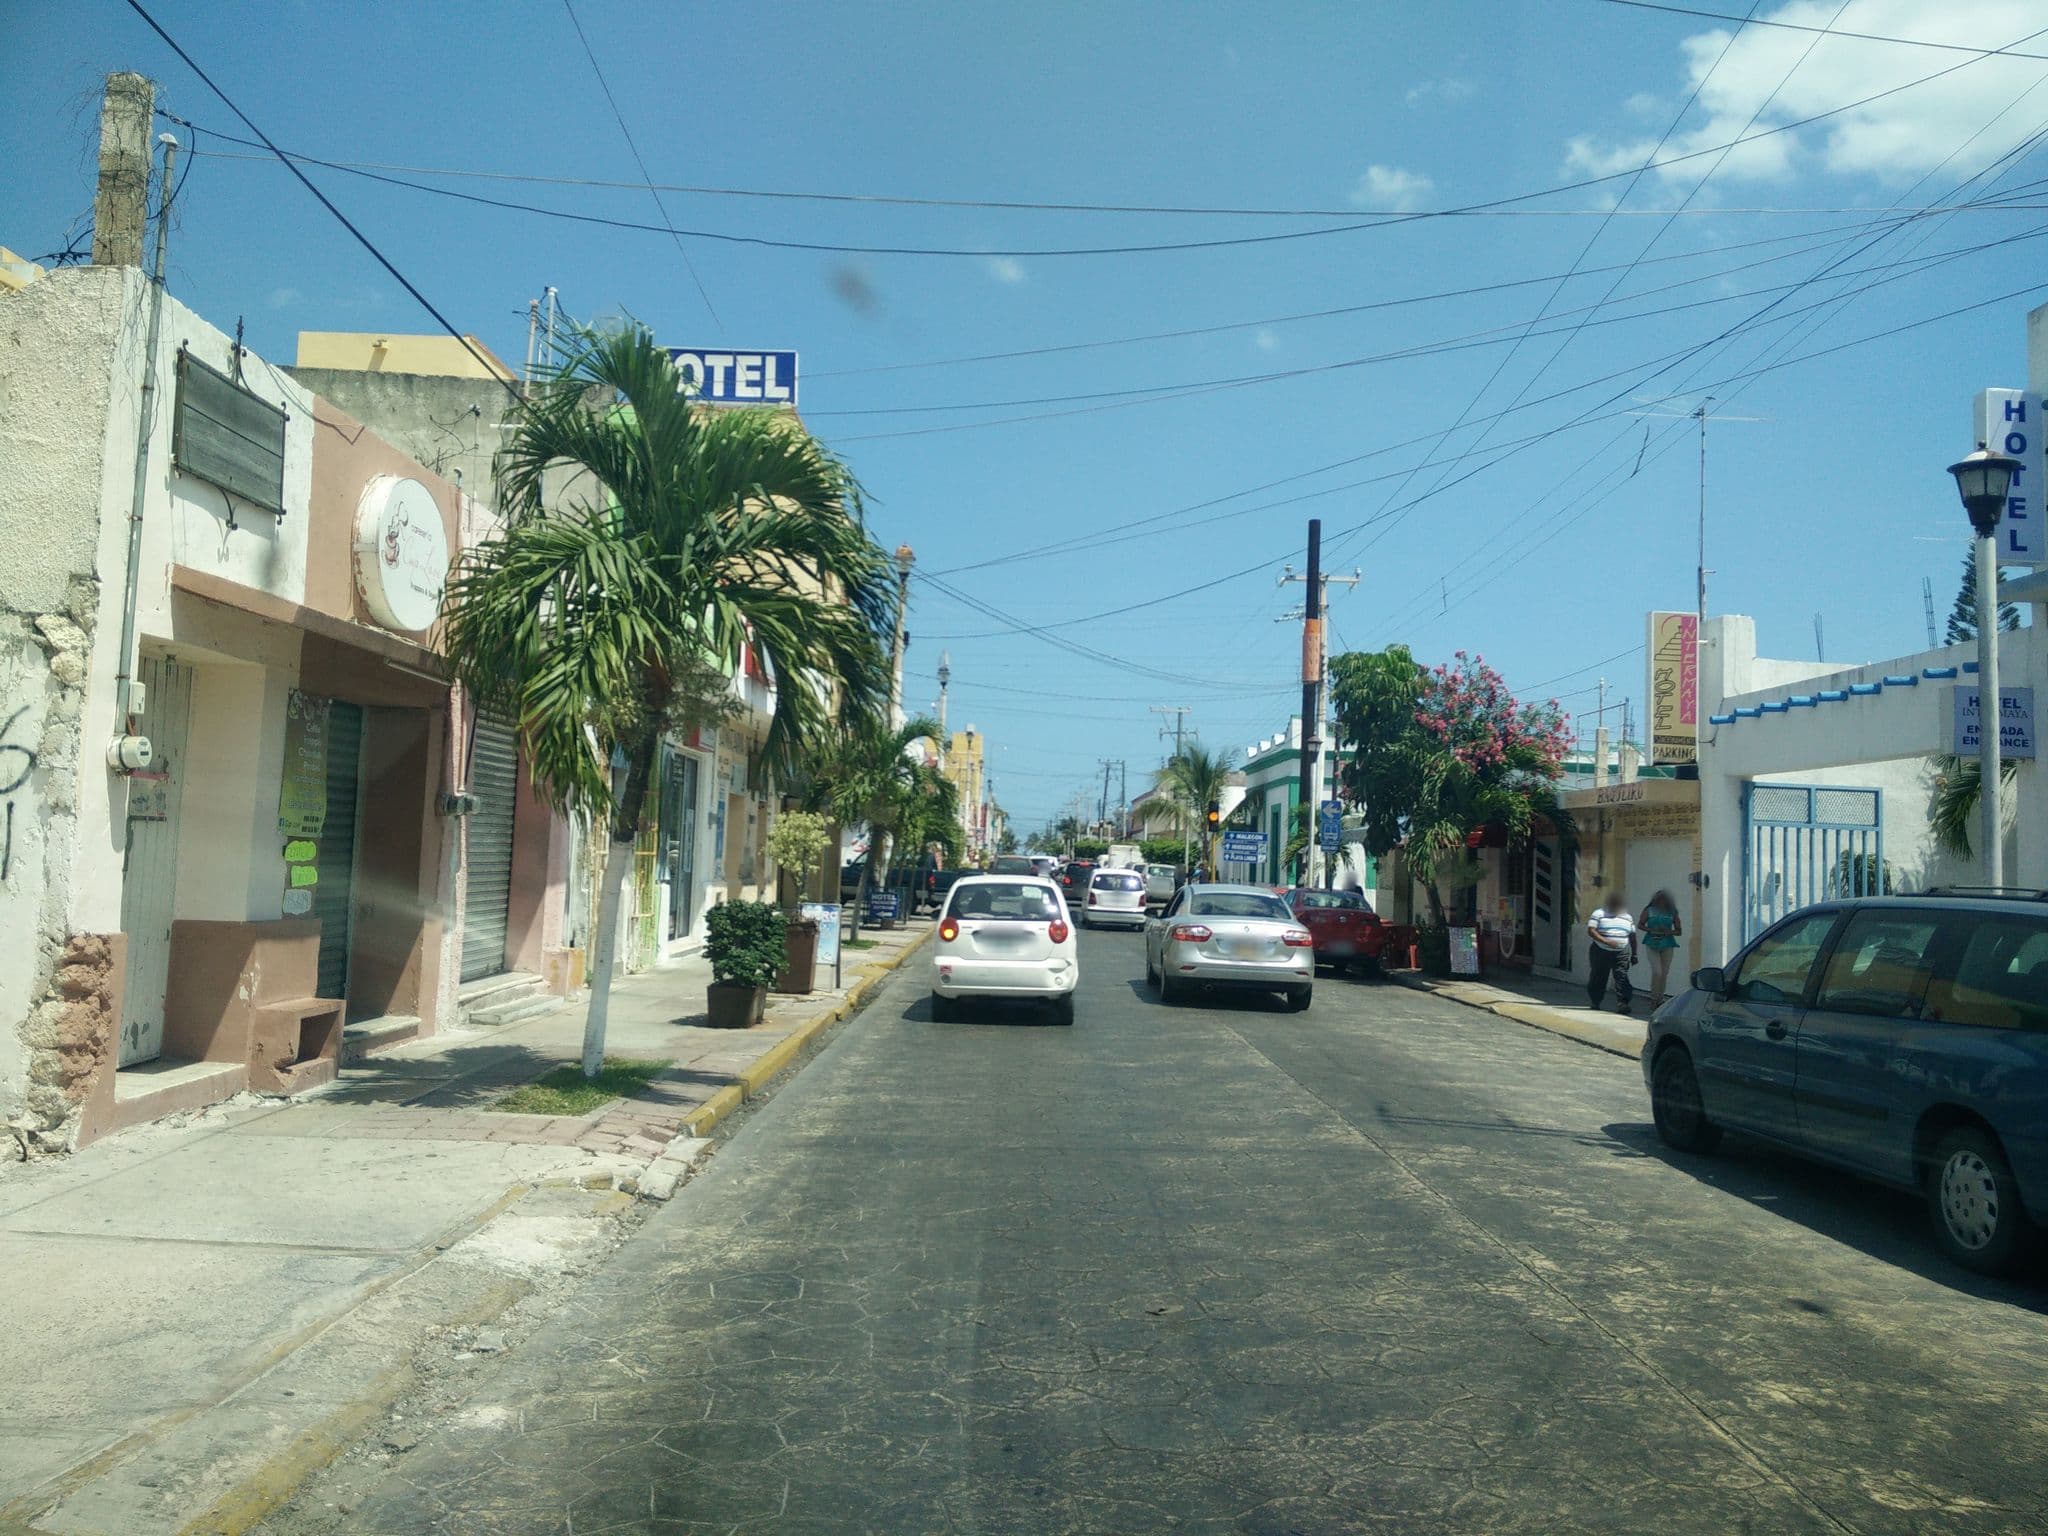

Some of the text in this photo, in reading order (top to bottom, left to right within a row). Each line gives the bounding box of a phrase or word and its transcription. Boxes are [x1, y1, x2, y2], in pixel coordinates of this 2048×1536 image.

[673, 352, 790, 399] OTEL
[2004, 399, 2028, 553] HOTEL
[1968, 695, 2022, 709] HEL
[1962, 707, 2028, 719] INTMAYA
[1966, 725, 2025, 736] ENADA
[1962, 736, 2030, 748] ENANCE
[1653, 746, 1697, 759] PARKING
